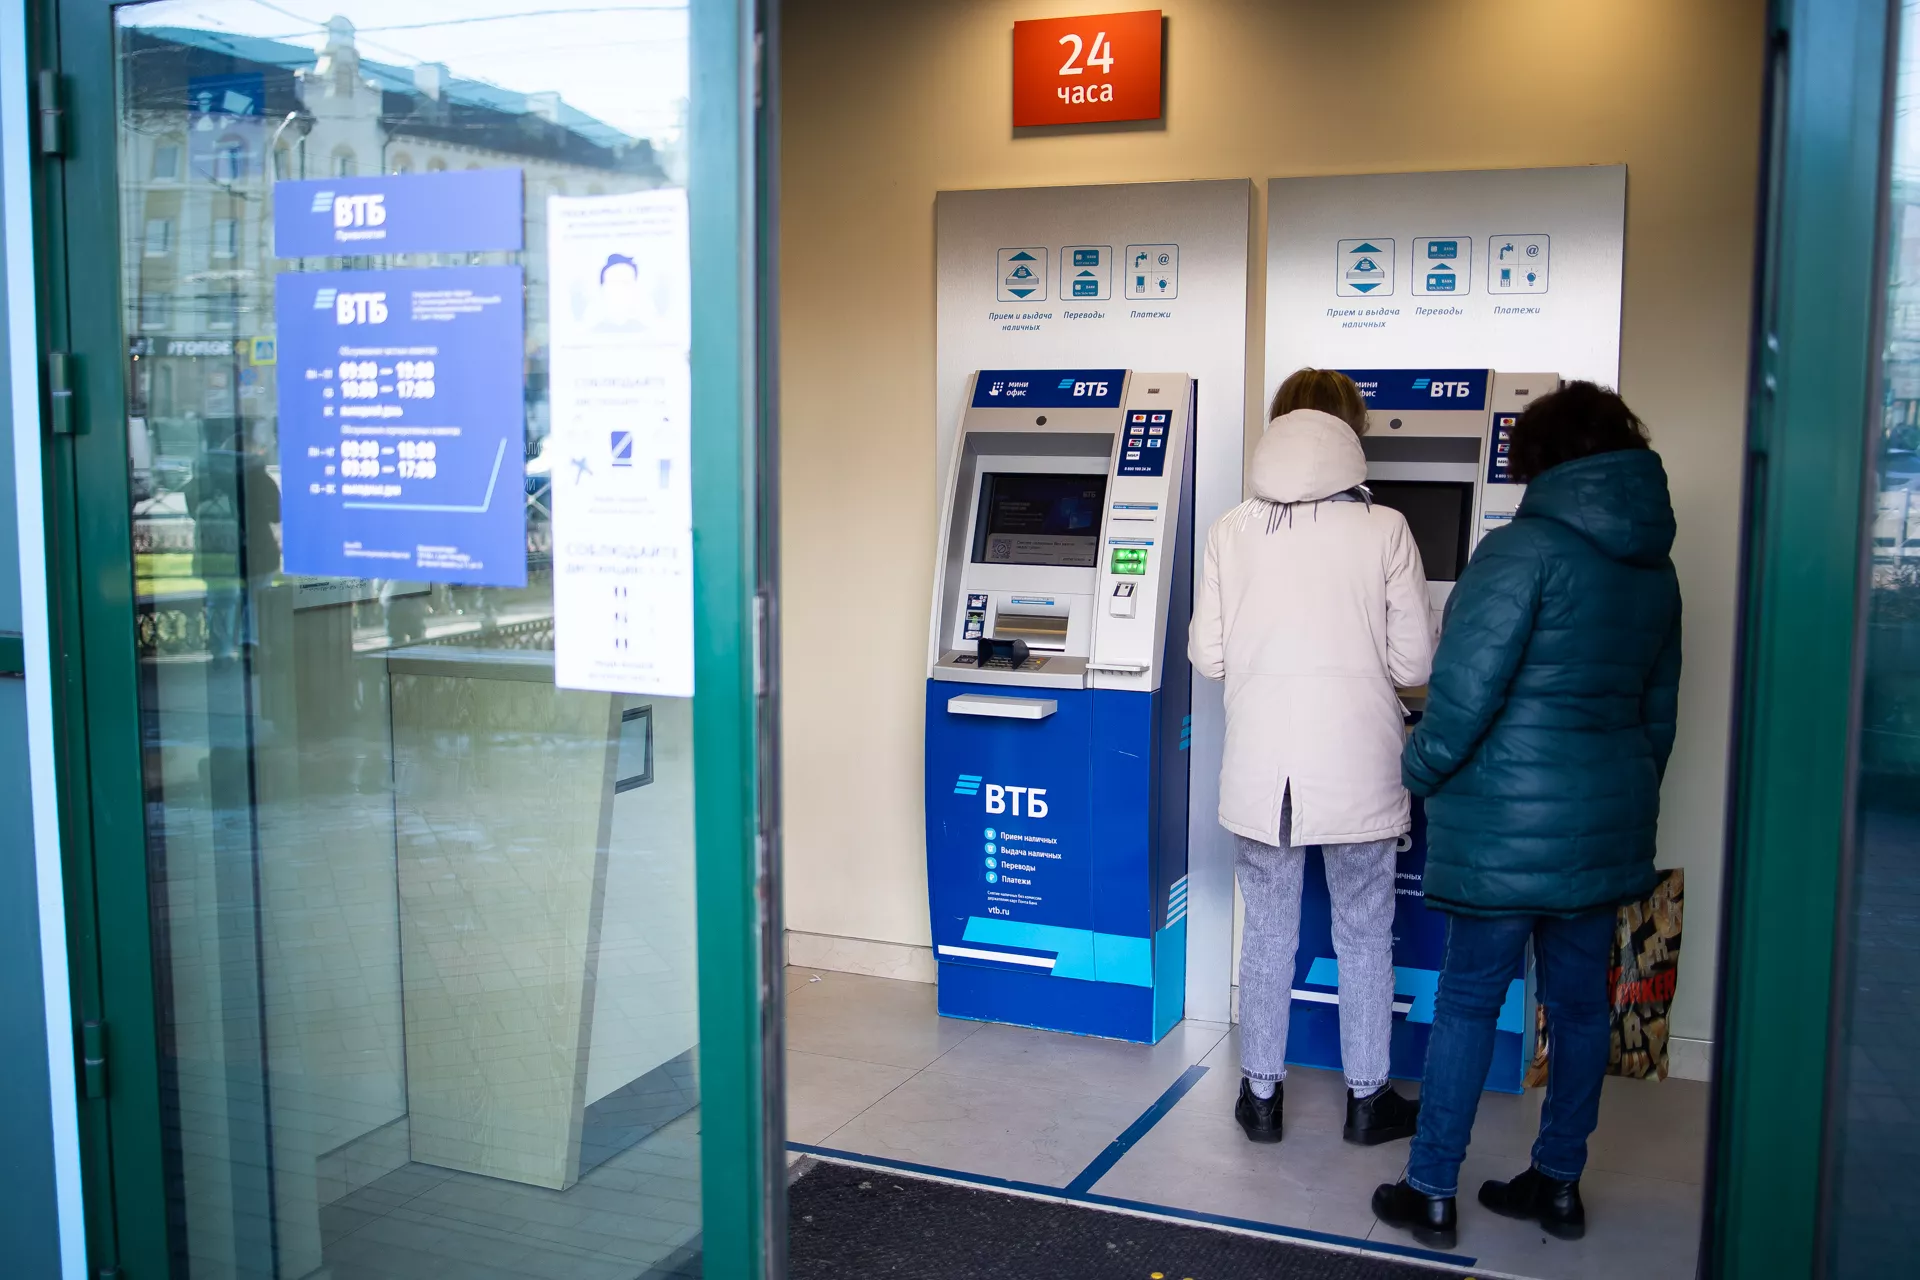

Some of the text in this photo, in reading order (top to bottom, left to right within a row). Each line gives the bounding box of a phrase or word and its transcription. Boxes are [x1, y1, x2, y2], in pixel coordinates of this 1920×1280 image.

[1058, 31, 1114, 76] 24
[1057, 83, 1113, 104] часа
[334, 194, 387, 228] ВТБ
[336, 292, 389, 325] ВТБ
[1326, 308, 1356, 318] Прием
[1366, 307, 1400, 316] выдача
[1415, 306, 1464, 316] Переводы
[1493, 306, 1541, 315] Платежи
[988, 312, 1014, 321] Прием
[1022, 312, 1053, 320] выдача
[1063, 311, 1106, 320] Переводы
[1130, 310, 1171, 319] Платежи
[1002, 323, 1041, 331] наличных
[1342, 320, 1387, 329] наличных
[1006, 388, 1027, 397] офис
[1073, 381, 1108, 397] ВТБ
[1358, 388, 1377, 398] фис
[1430, 381, 1470, 398] ВТБ
[985, 783, 1049, 819] ВТБ
[1000, 831, 1058, 844] Прием наличных
[1000, 846, 1062, 860] Выдача наличных
[1001, 860, 1036, 872] Переводы
[1001, 875, 1032, 886] Платежи
[1396, 872, 1422, 881] ичных
[1395, 888, 1425, 897] личных
[988, 906, 1010, 916] vtb.ru
